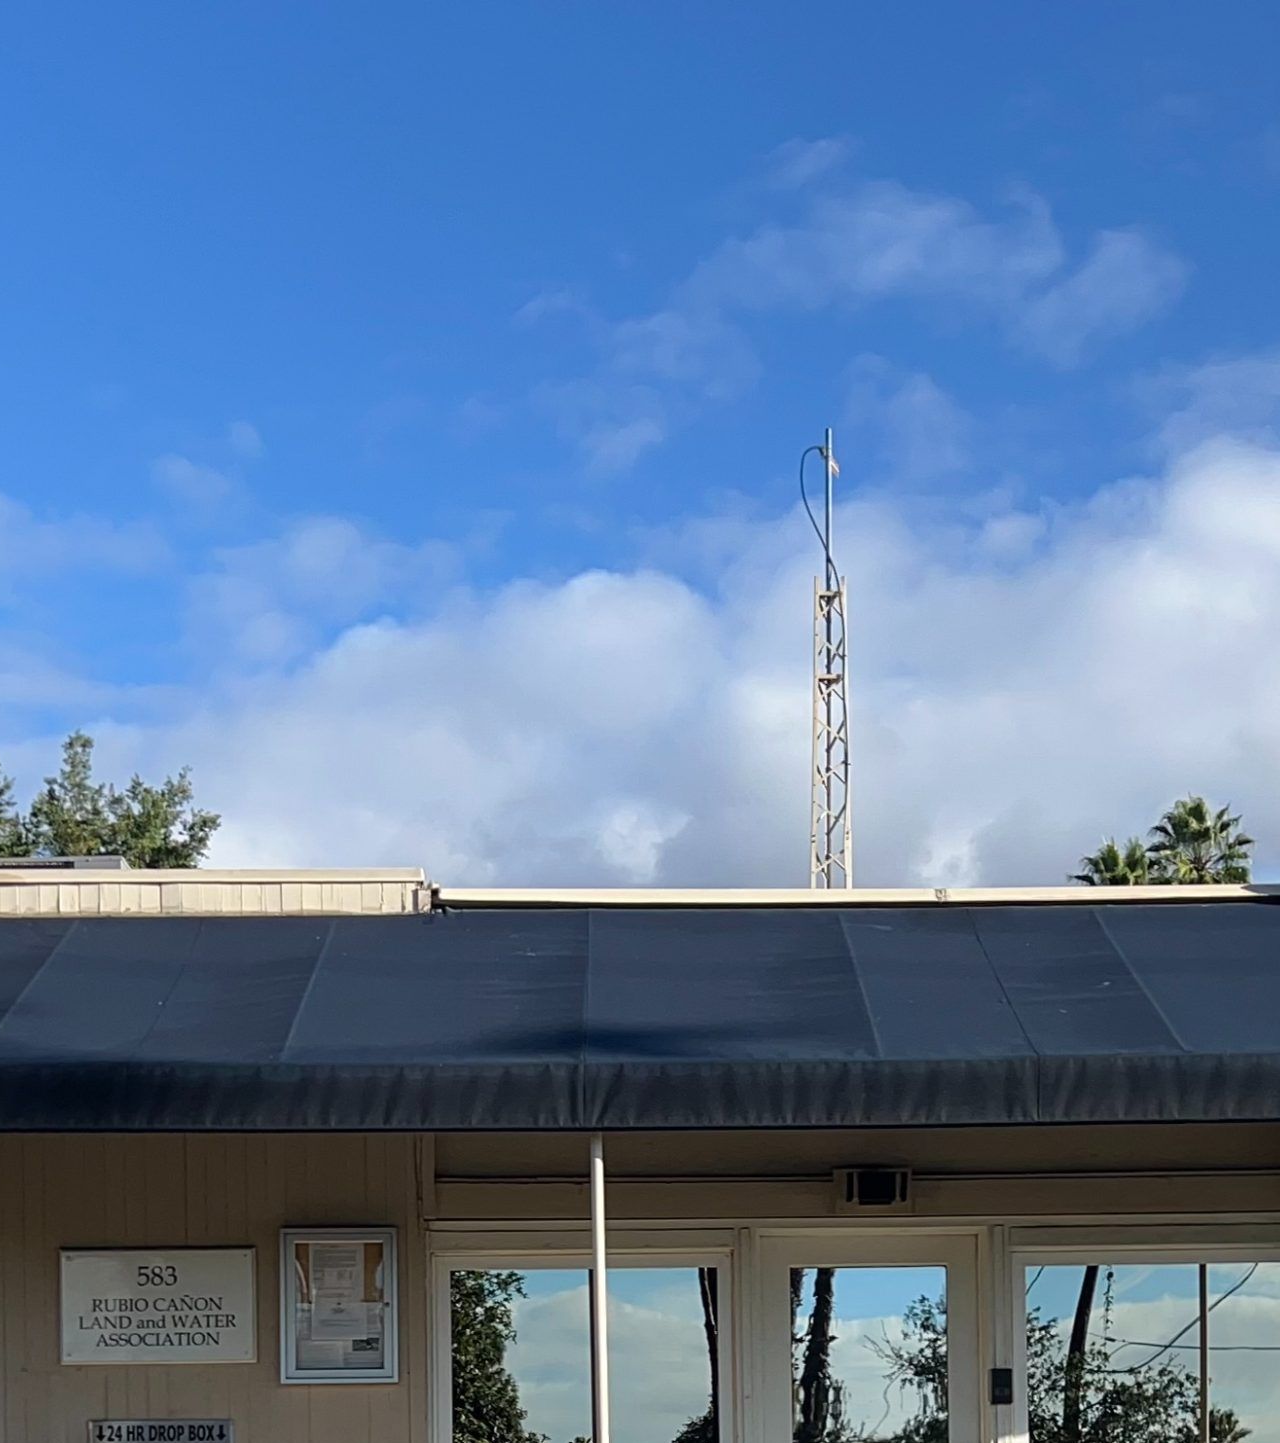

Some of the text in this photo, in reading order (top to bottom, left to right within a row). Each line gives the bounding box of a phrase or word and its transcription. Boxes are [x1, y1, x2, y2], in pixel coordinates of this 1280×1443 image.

[136, 1265, 179, 1287] 583
[92, 1294, 223, 1312] RUBIO CAÑON
[79, 1314, 236, 1330] LAND and WATER
[96, 1332, 220, 1347] ASSOCIATION
[107, 1425, 215, 1442] 24 HR DROP BOX
